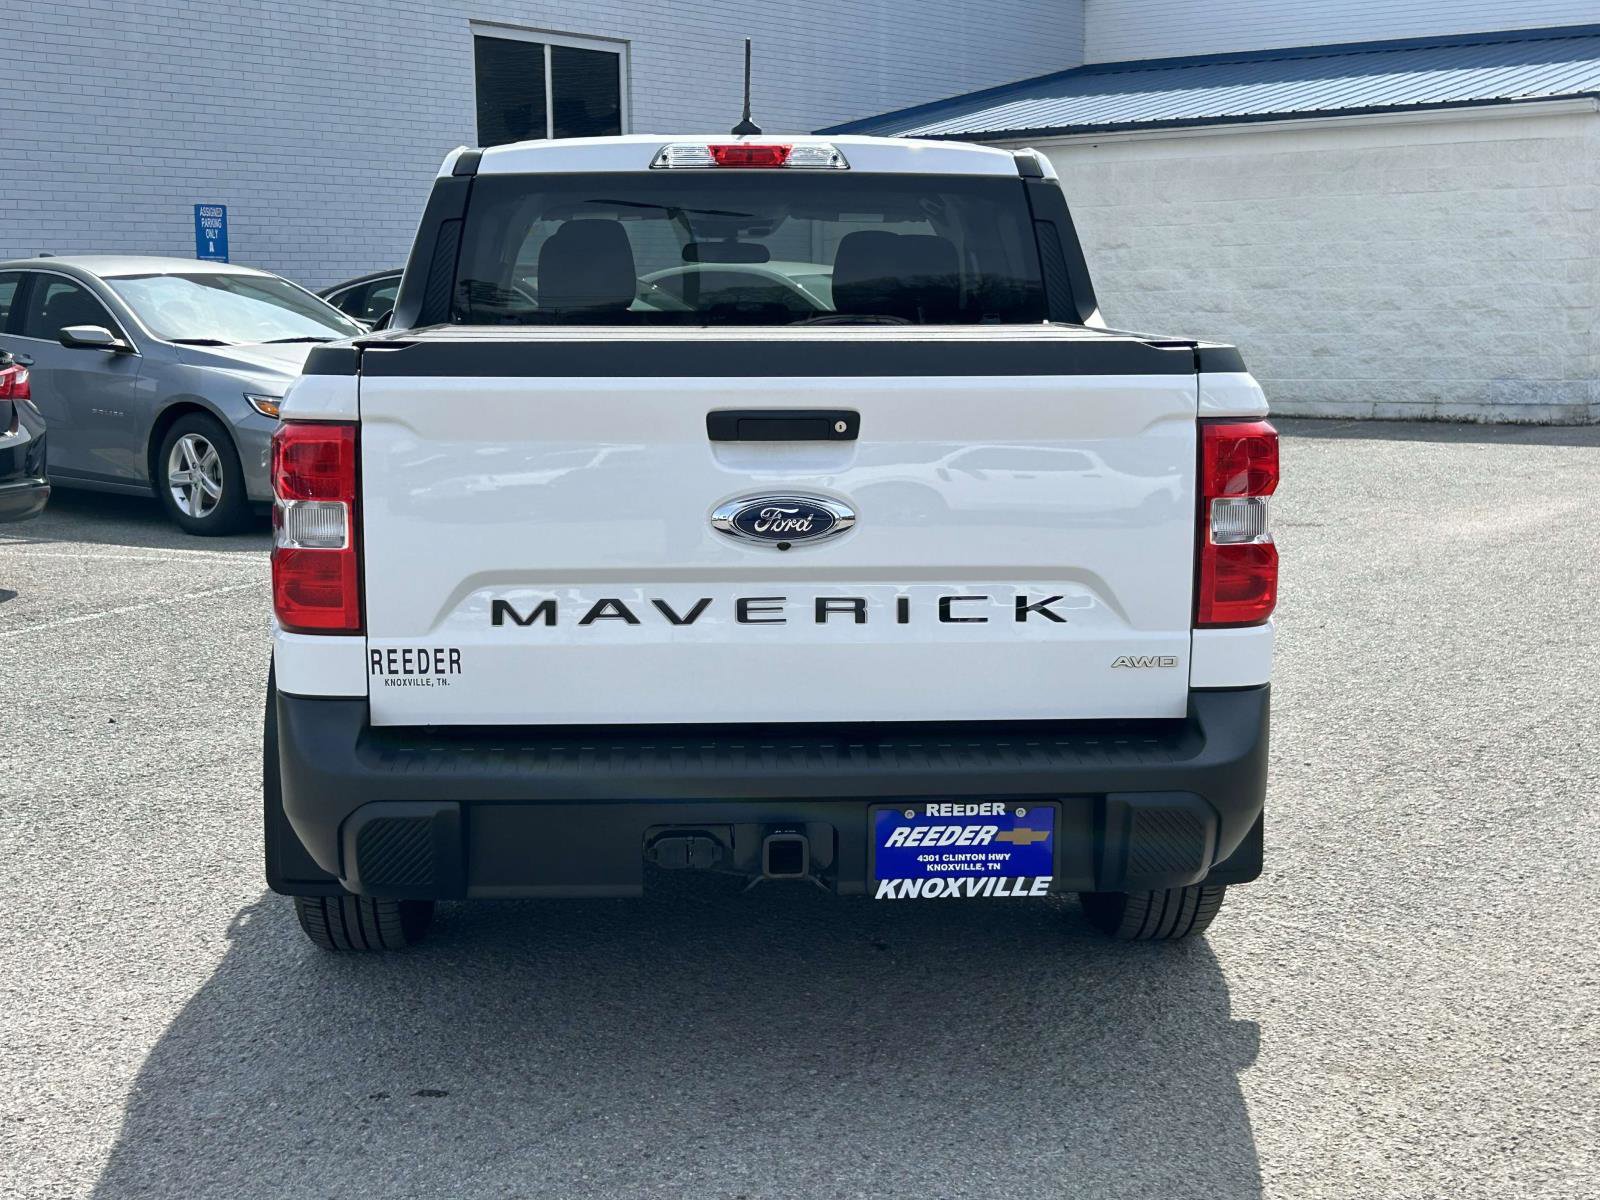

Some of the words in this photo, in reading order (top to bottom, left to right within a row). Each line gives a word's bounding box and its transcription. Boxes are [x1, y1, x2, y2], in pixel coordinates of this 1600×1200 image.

[200, 206, 223, 217] ASSIGNED
[201, 217, 222, 228] PARKING
[205, 228, 218, 239] ONLY
[754, 507, 813, 532] Ford
[490, 595, 1068, 626] MAVERICK
[370, 648, 462, 675] REEDER
[1110, 656, 1178, 668] AWD
[384, 678, 434, 687] KNOXVILLE,
[436, 678, 450, 686] TN.
[926, 803, 1006, 817] REEDER
[884, 825, 998, 848] REEDER
[917, 854, 940, 862] 4301
[926, 863, 985, 871] KNOXVILLE,
[987, 862, 1001, 870] TN
[874, 876, 1053, 900] KNOXVILLE
